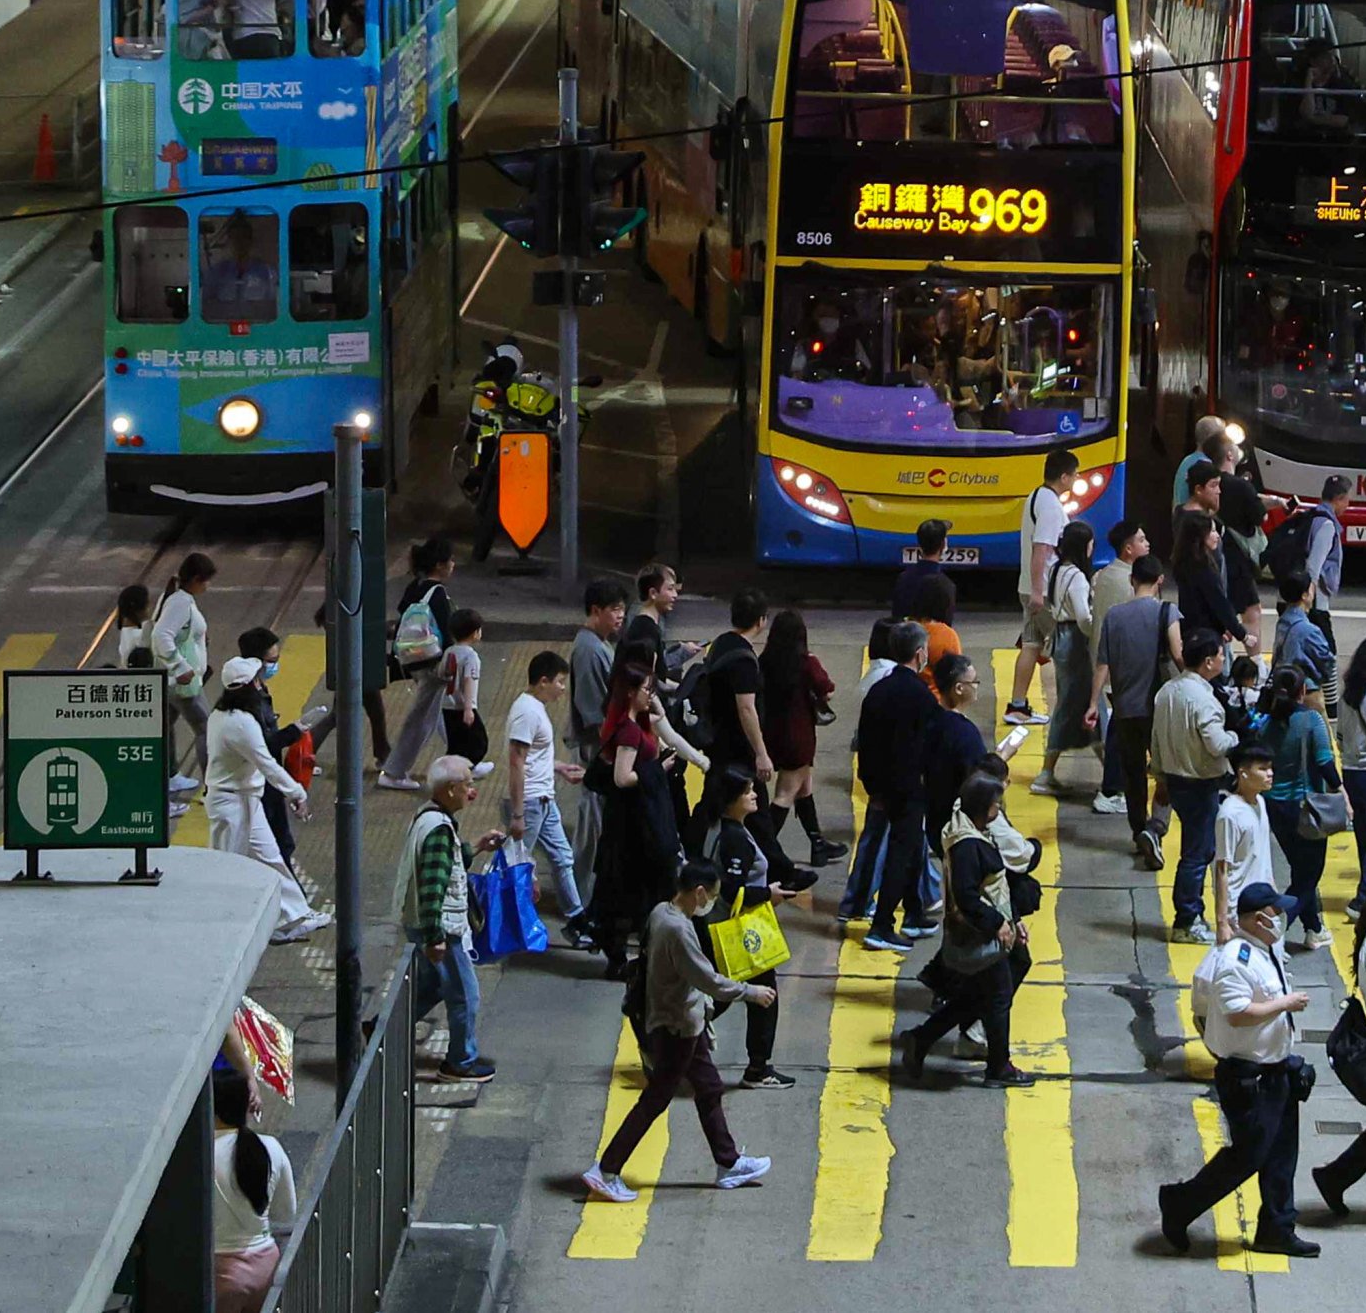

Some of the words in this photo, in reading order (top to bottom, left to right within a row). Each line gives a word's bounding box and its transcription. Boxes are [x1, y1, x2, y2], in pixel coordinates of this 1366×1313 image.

[221, 101, 255, 111] CHINA
[259, 101, 303, 111] TAIPING
[859, 182, 965, 214] 銅鑼灣
[969, 187, 1048, 235] 969
[1317, 207, 1360, 222] SHEUNG
[853, 209, 934, 235] Causeway
[939, 209, 970, 235] Bay
[796, 232, 832, 247] 8506
[896, 470, 925, 486] 城巴
[948, 470, 1000, 488] Citybus
[939, 549, 977, 562] 259
[67, 684, 153, 704] 百德新街
[55, 708, 111, 719] Paterson
[115, 708, 153, 719] Street
[118, 746, 154, 762] 53E
[101, 825, 154, 835] Eastbound
